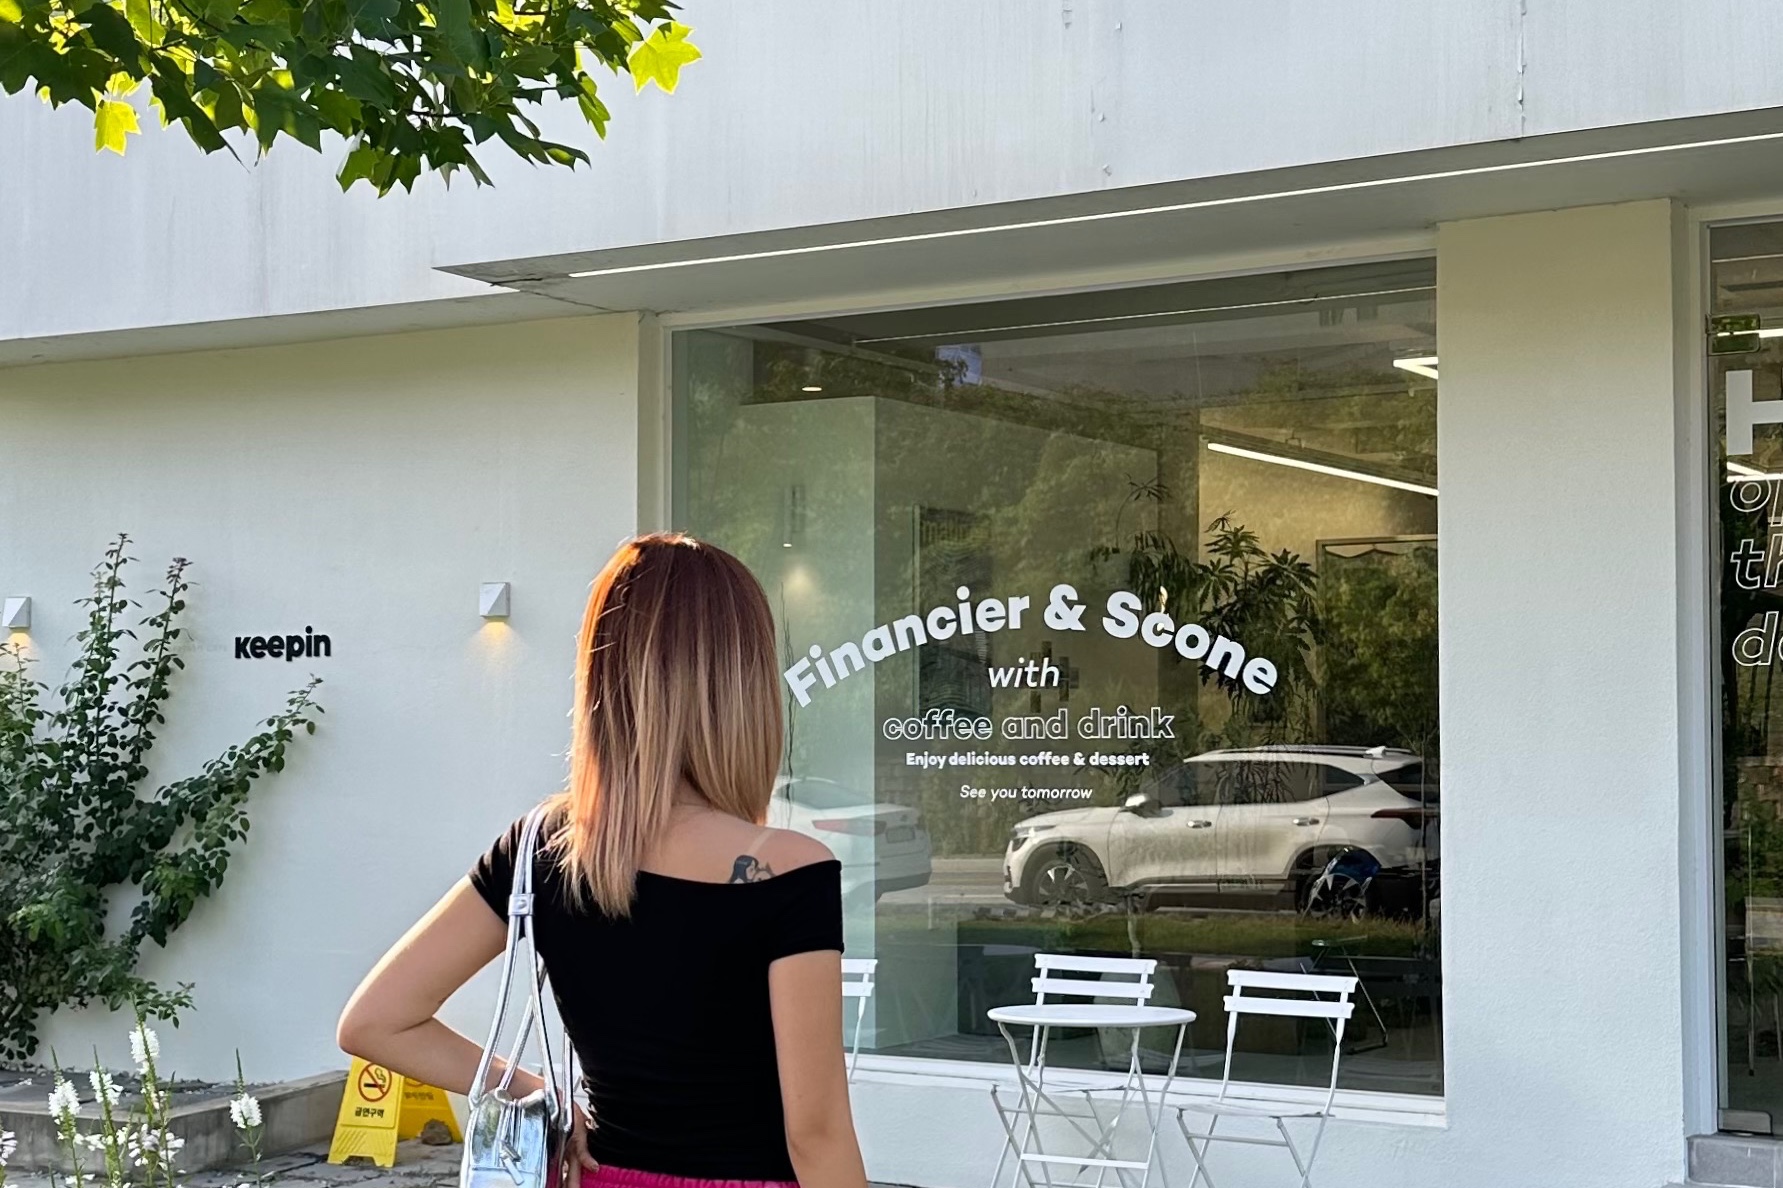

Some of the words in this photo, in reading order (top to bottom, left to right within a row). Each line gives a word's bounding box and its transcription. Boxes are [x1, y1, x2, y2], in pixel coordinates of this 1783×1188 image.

[234, 625, 332, 662] keepin
[784, 585, 1030, 709] Financier
[1043, 583, 1087, 632] &
[1102, 590, 1278, 695] Scone
[988, 656, 1061, 689] with
[882, 707, 994, 741] coffee
[1001, 707, 1069, 740] and
[1076, 704, 1176, 740] drink
[905, 750, 948, 770] Enjoy
[948, 751, 1017, 767] delicious
[1019, 750, 1070, 767] coffee
[1073, 751, 1087, 767] &
[1089, 751, 1151, 767] dessert
[959, 784, 987, 799] See
[990, 787, 1018, 803] you
[1021, 785, 1094, 800] tomorrow
[354, 1107, 385, 1118] 금연구역
